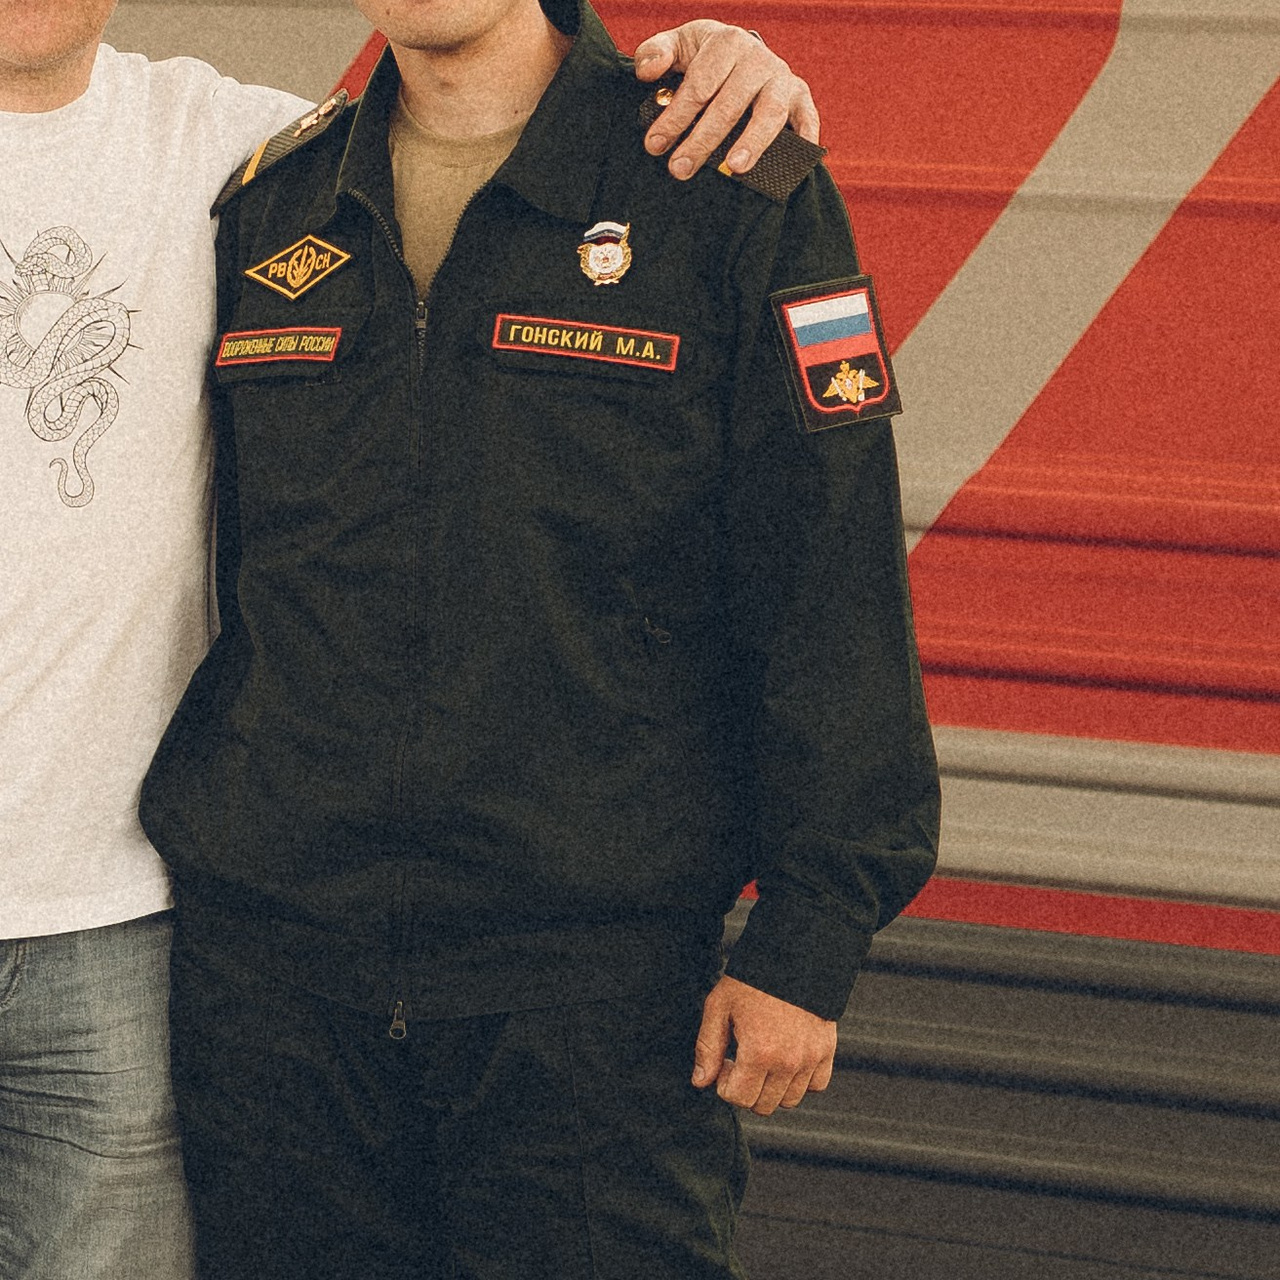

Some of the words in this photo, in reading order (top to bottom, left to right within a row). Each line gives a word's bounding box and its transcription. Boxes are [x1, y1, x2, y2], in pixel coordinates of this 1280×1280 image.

[274, 335, 300, 353] СИЛЫ
[298, 335, 336, 353] РОССИИ
[508, 324, 603, 352] ГОНСКИЙ
[616, 336, 661, 360] М.А.
